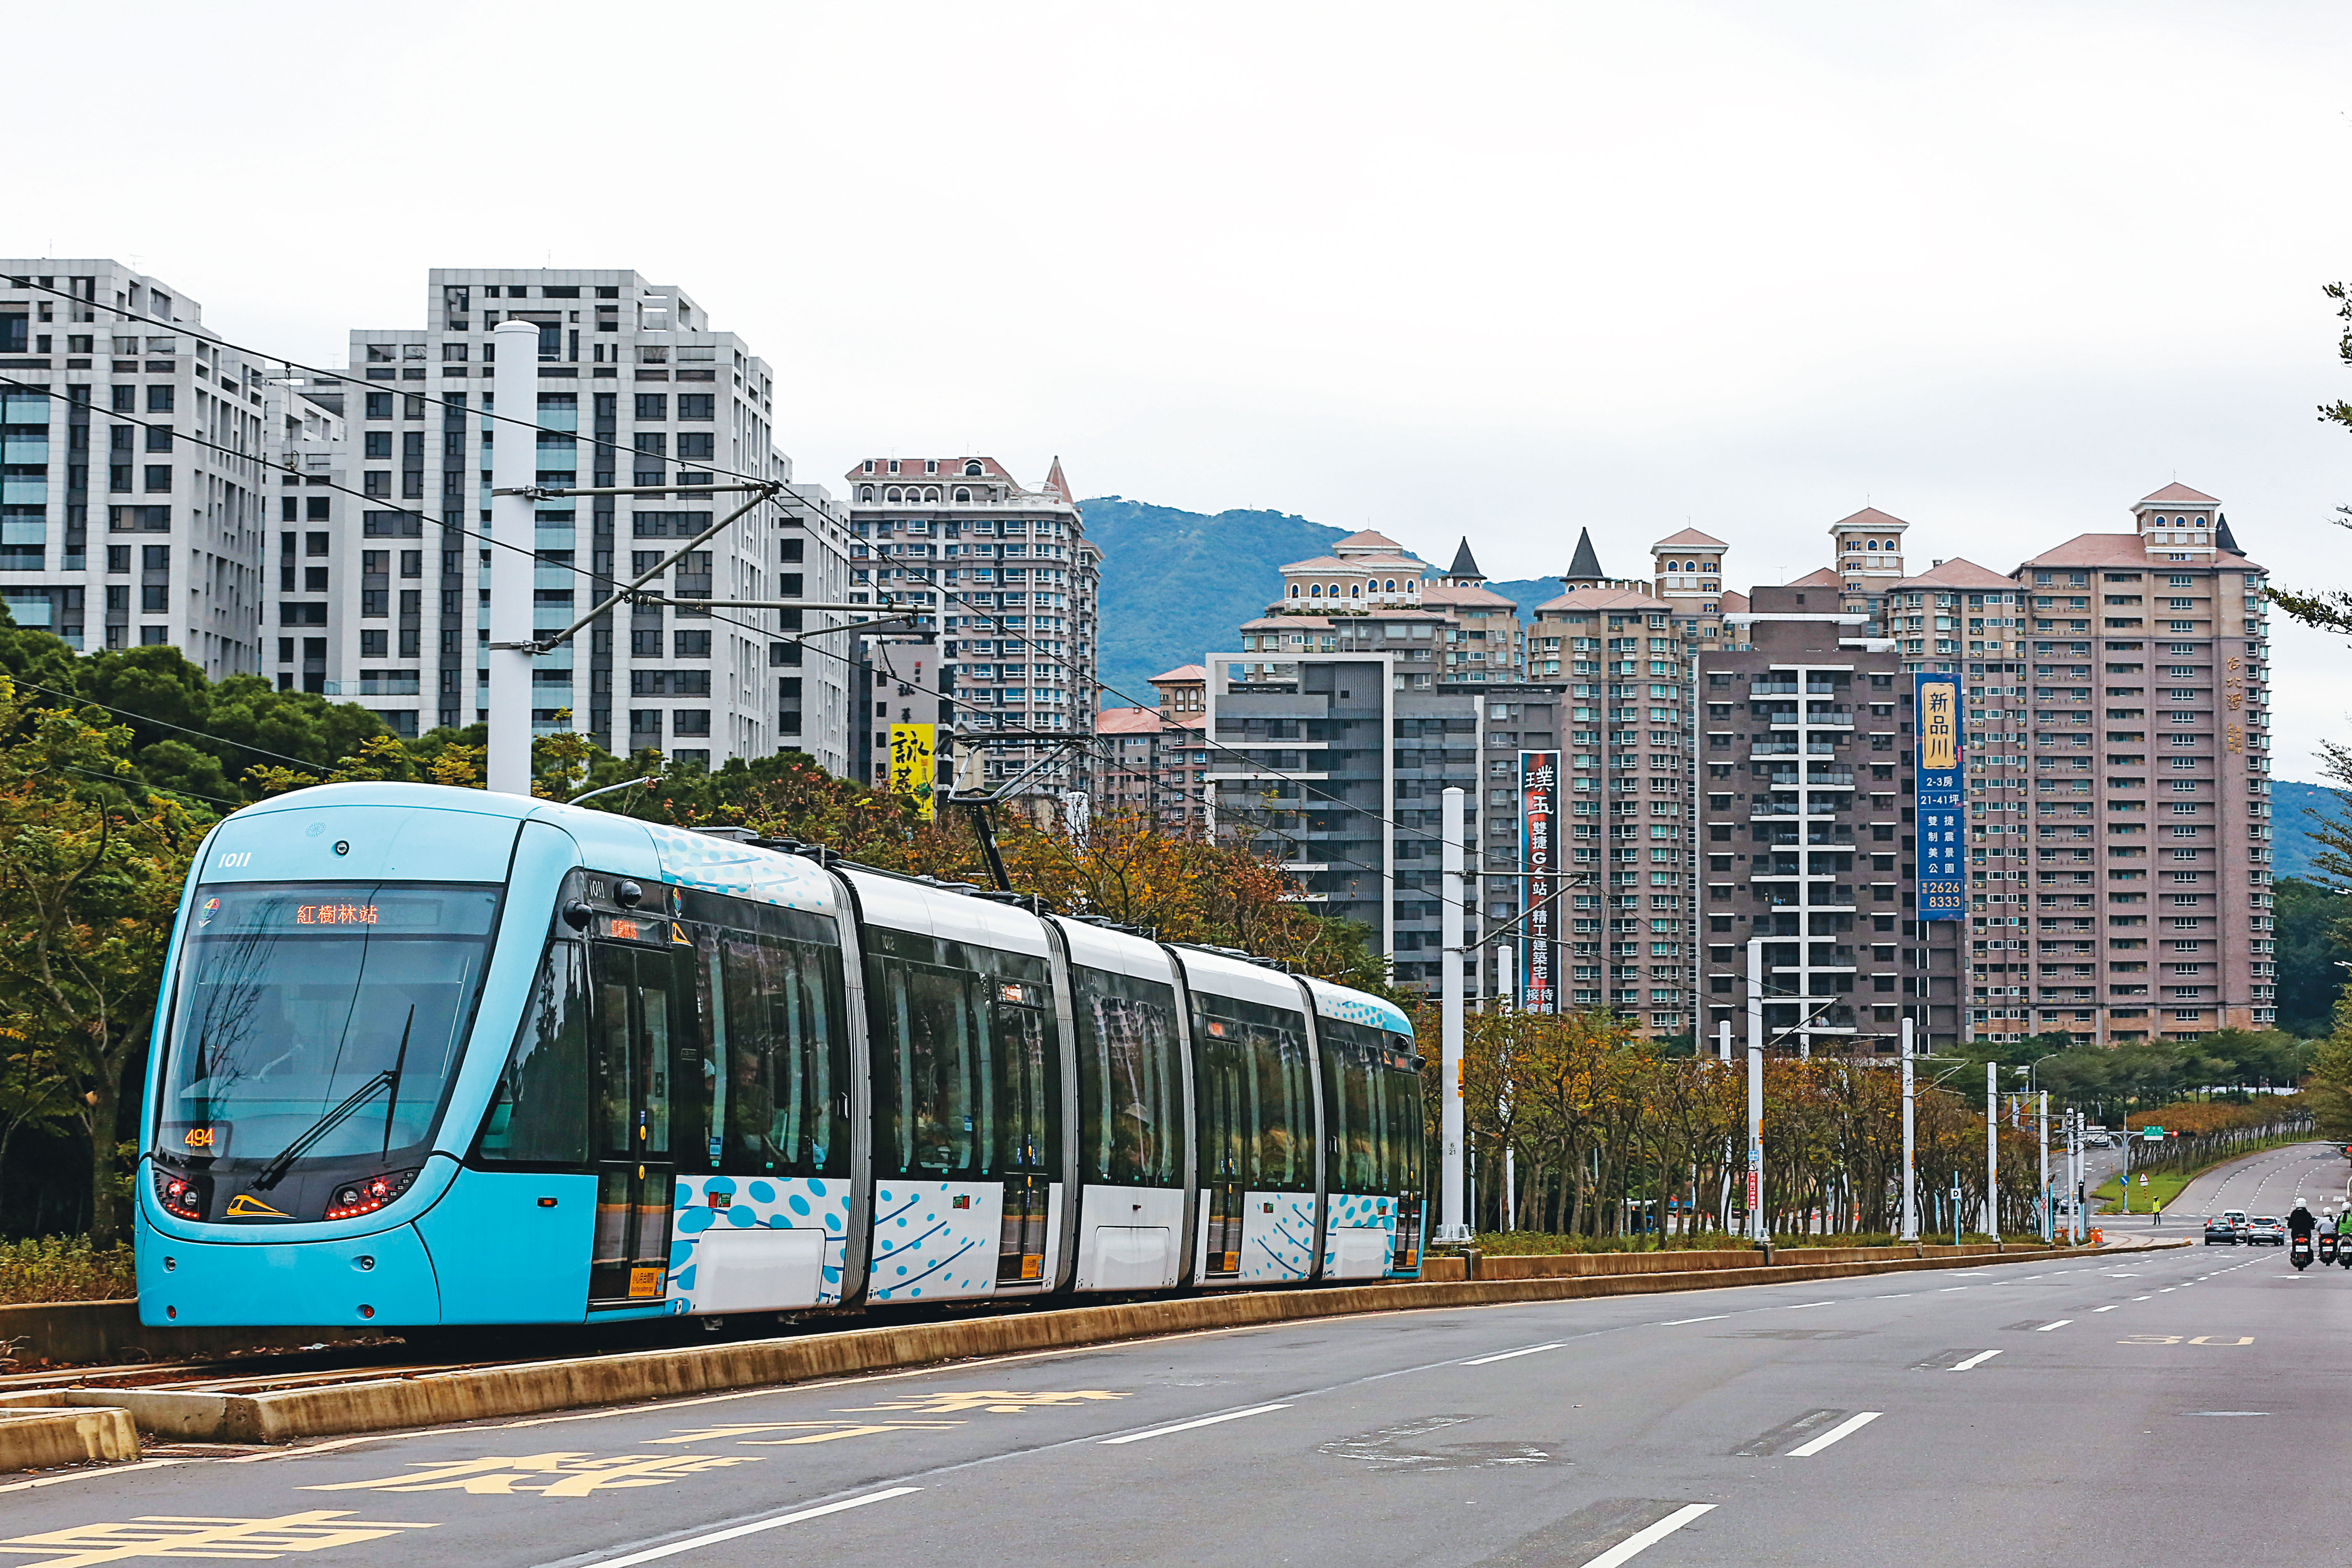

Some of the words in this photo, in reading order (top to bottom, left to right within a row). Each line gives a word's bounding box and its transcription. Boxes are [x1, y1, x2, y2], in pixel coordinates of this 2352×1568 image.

[1928, 692, 1948, 758] 新品川
[1926, 776, 1953, 787] 2-3房
[1524, 765, 1554, 815] 璞玉
[1921, 794, 1959, 805] 21-41坪
[1928, 815, 1954, 826] 雙捷
[1928, 832, 1954, 842] 制震
[1928, 847, 1954, 858] 美景
[218, 852, 251, 869] 1011
[1928, 863, 1954, 873] 公園
[589, 879, 605, 899] 1011
[1930, 882, 1960, 893] 2626
[1929, 896, 1960, 907] 8333
[296, 904, 378, 924] 紅樹林站
[1526, 988, 1553, 1001] 接待
[1527, 1003, 1553, 1015] 會館
[184, 1128, 215, 1147] 494
